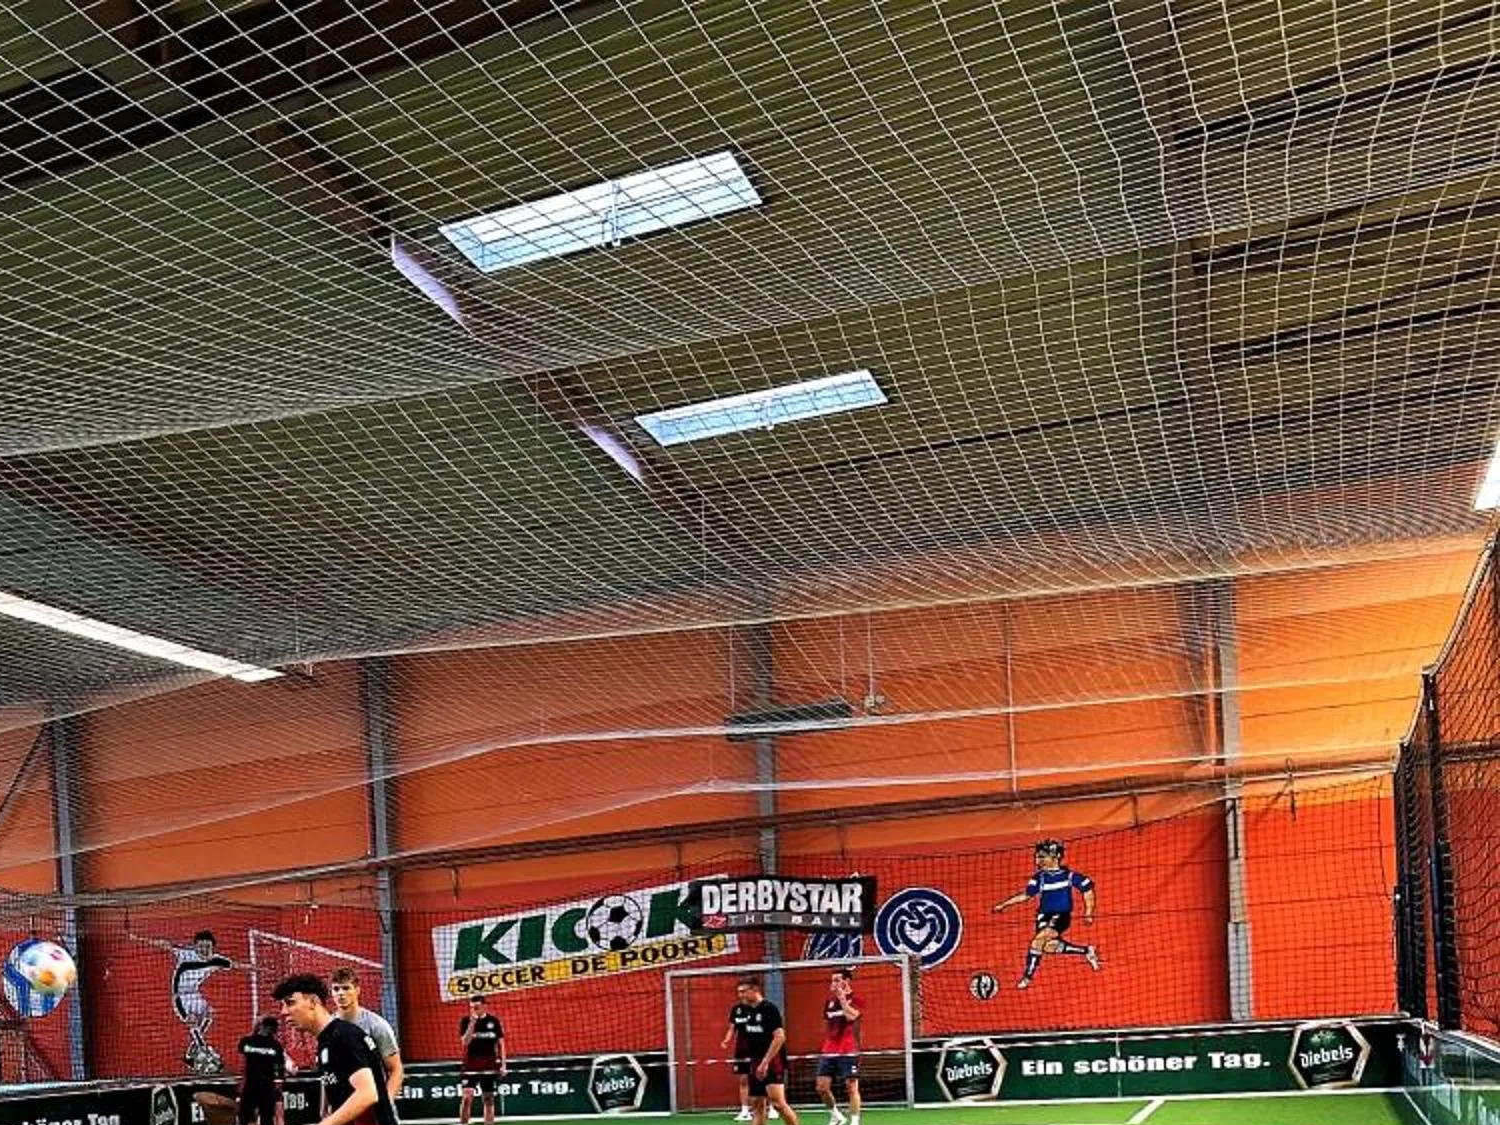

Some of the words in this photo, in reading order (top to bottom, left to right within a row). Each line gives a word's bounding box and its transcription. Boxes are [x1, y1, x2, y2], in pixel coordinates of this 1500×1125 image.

[702, 880, 863, 914] DERBYSTAR
[729, 914, 772, 926] THE
[791, 915, 861, 927] BALL
[456, 966, 546, 993] SOCCER
[571, 957, 607, 975] DE
[620, 936, 716, 967] POORT
[1021, 1059, 1063, 1076] Ein
[1073, 1055, 1198, 1076] schöner
[1208, 1051, 1271, 1069] Tag.
[1298, 1045, 1354, 1068] Diebels
[945, 1061, 993, 1082] Diebels
[529, 1081, 575, 1096] Tag.
[282, 1091, 309, 1110] Tag.
